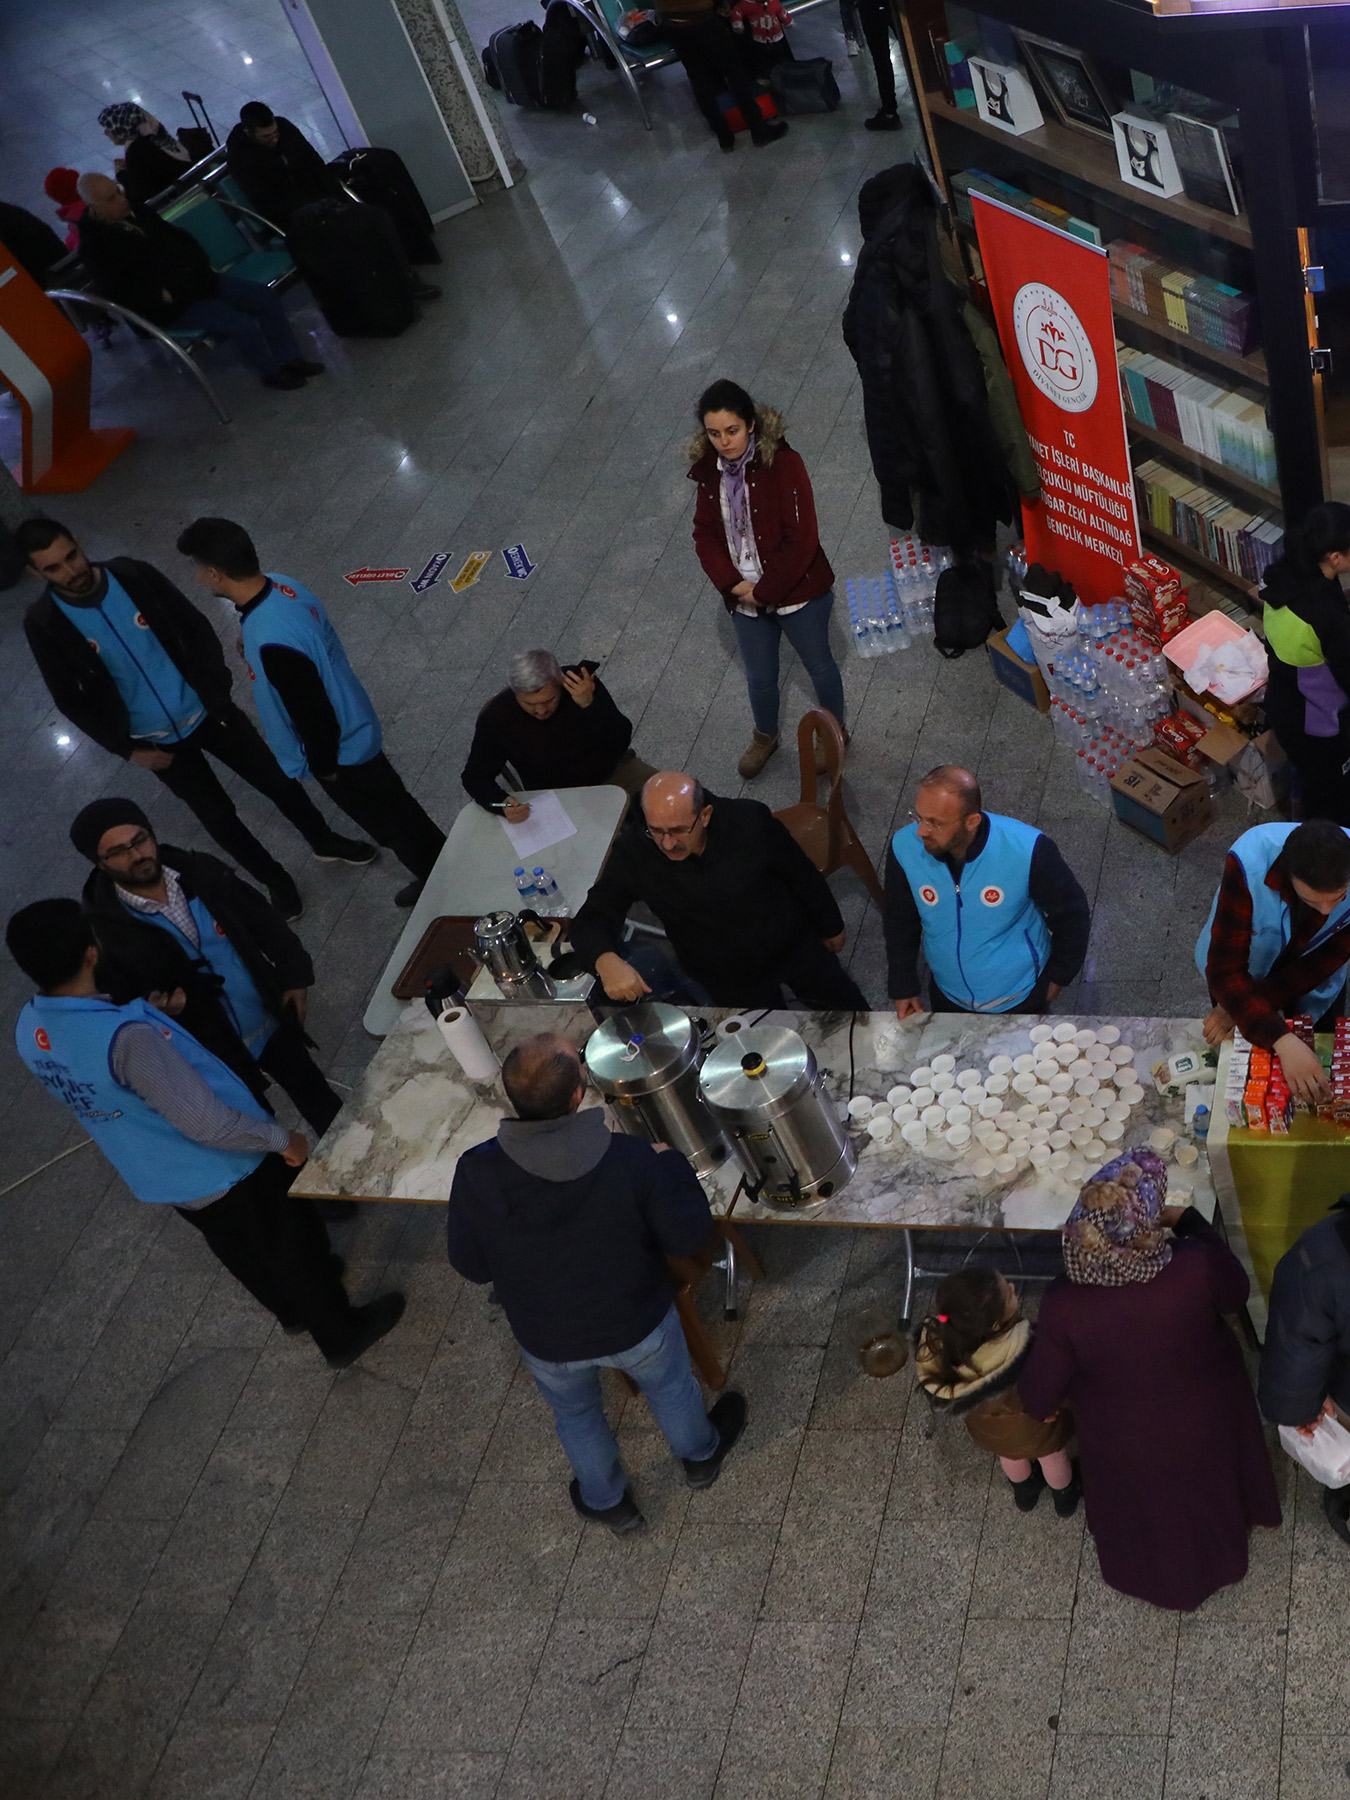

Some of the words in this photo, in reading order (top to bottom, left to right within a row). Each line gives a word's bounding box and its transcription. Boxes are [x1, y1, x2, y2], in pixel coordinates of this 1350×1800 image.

[1063, 429, 1076, 449] TC
[1026, 433, 1049, 460] YANET
[1051, 445, 1080, 475] İŞLERİ
[1081, 462, 1132, 500] BAŞKANLIĞ
[1036, 462, 1072, 494] ELÇUKLU
[1073, 482, 1128, 522] MÜFTÜLÜĞÜ
[1046, 515, 1084, 545] GENÇLİK
[1084, 534, 1124, 566] MERKEZİ
[1067, 502, 1087, 525] ZEKİ
[1089, 513, 1133, 547] ALTINDAĞ
